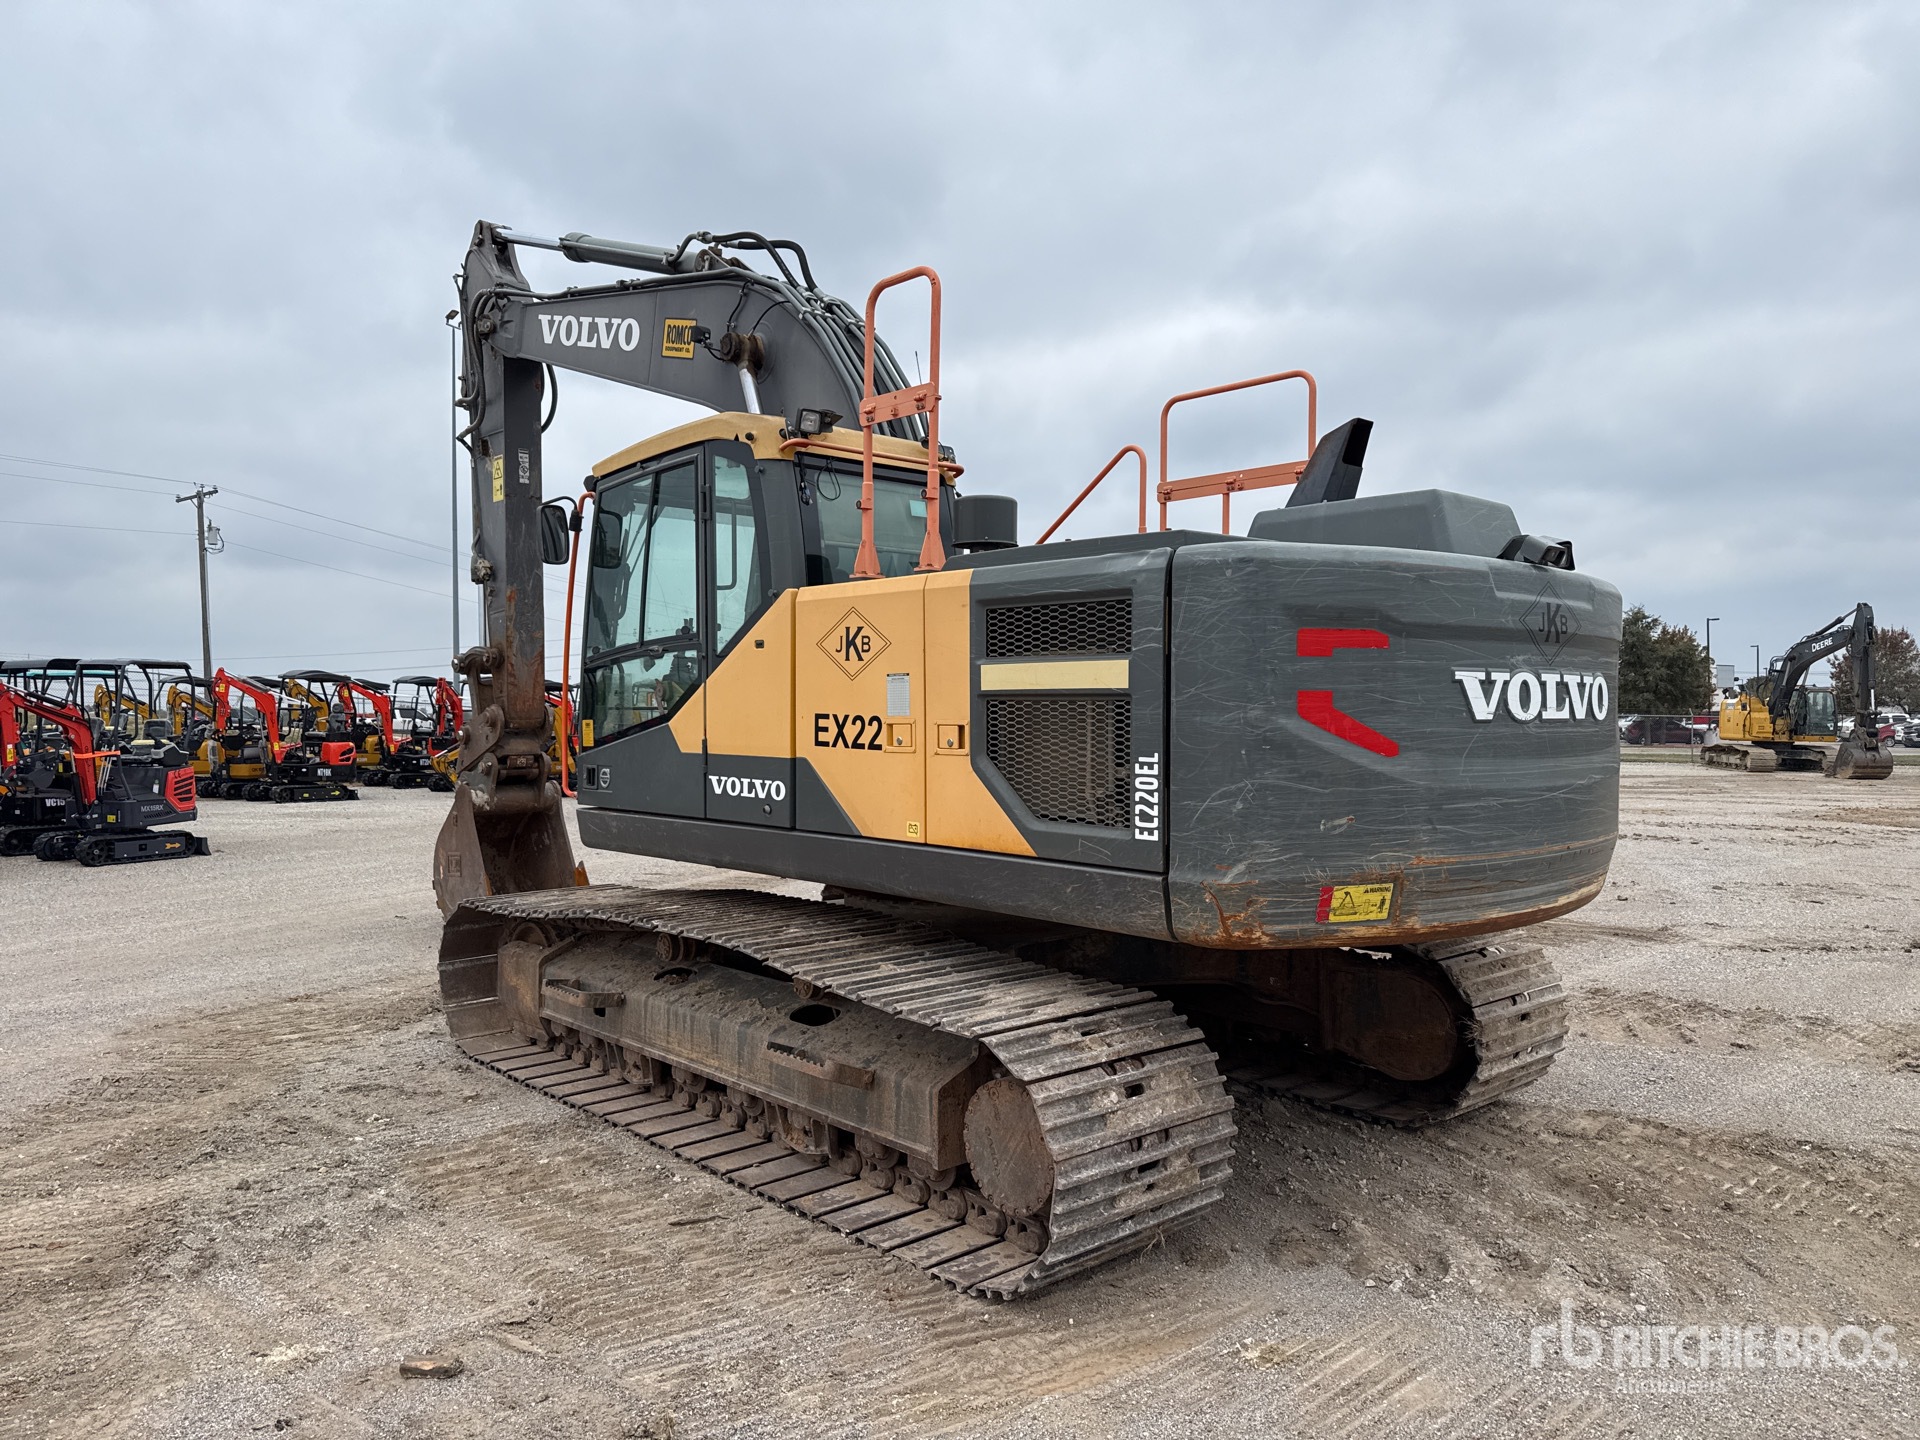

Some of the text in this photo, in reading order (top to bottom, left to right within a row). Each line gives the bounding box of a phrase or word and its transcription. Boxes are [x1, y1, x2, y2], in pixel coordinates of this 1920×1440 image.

[538, 314, 641, 352] VOLVO
[666, 325, 692, 346] ROMCO
[1538, 602, 1568, 644] JKB
[835, 626, 871, 662] JKB
[1811, 636, 1834, 653] DEERE
[1453, 669, 1610, 722] VOLVO
[814, 712, 883, 752] EX22
[709, 775, 786, 801] VOLVO
[1135, 752, 1159, 842] EC220EL
[1369, 885, 1392, 894] WARNING
